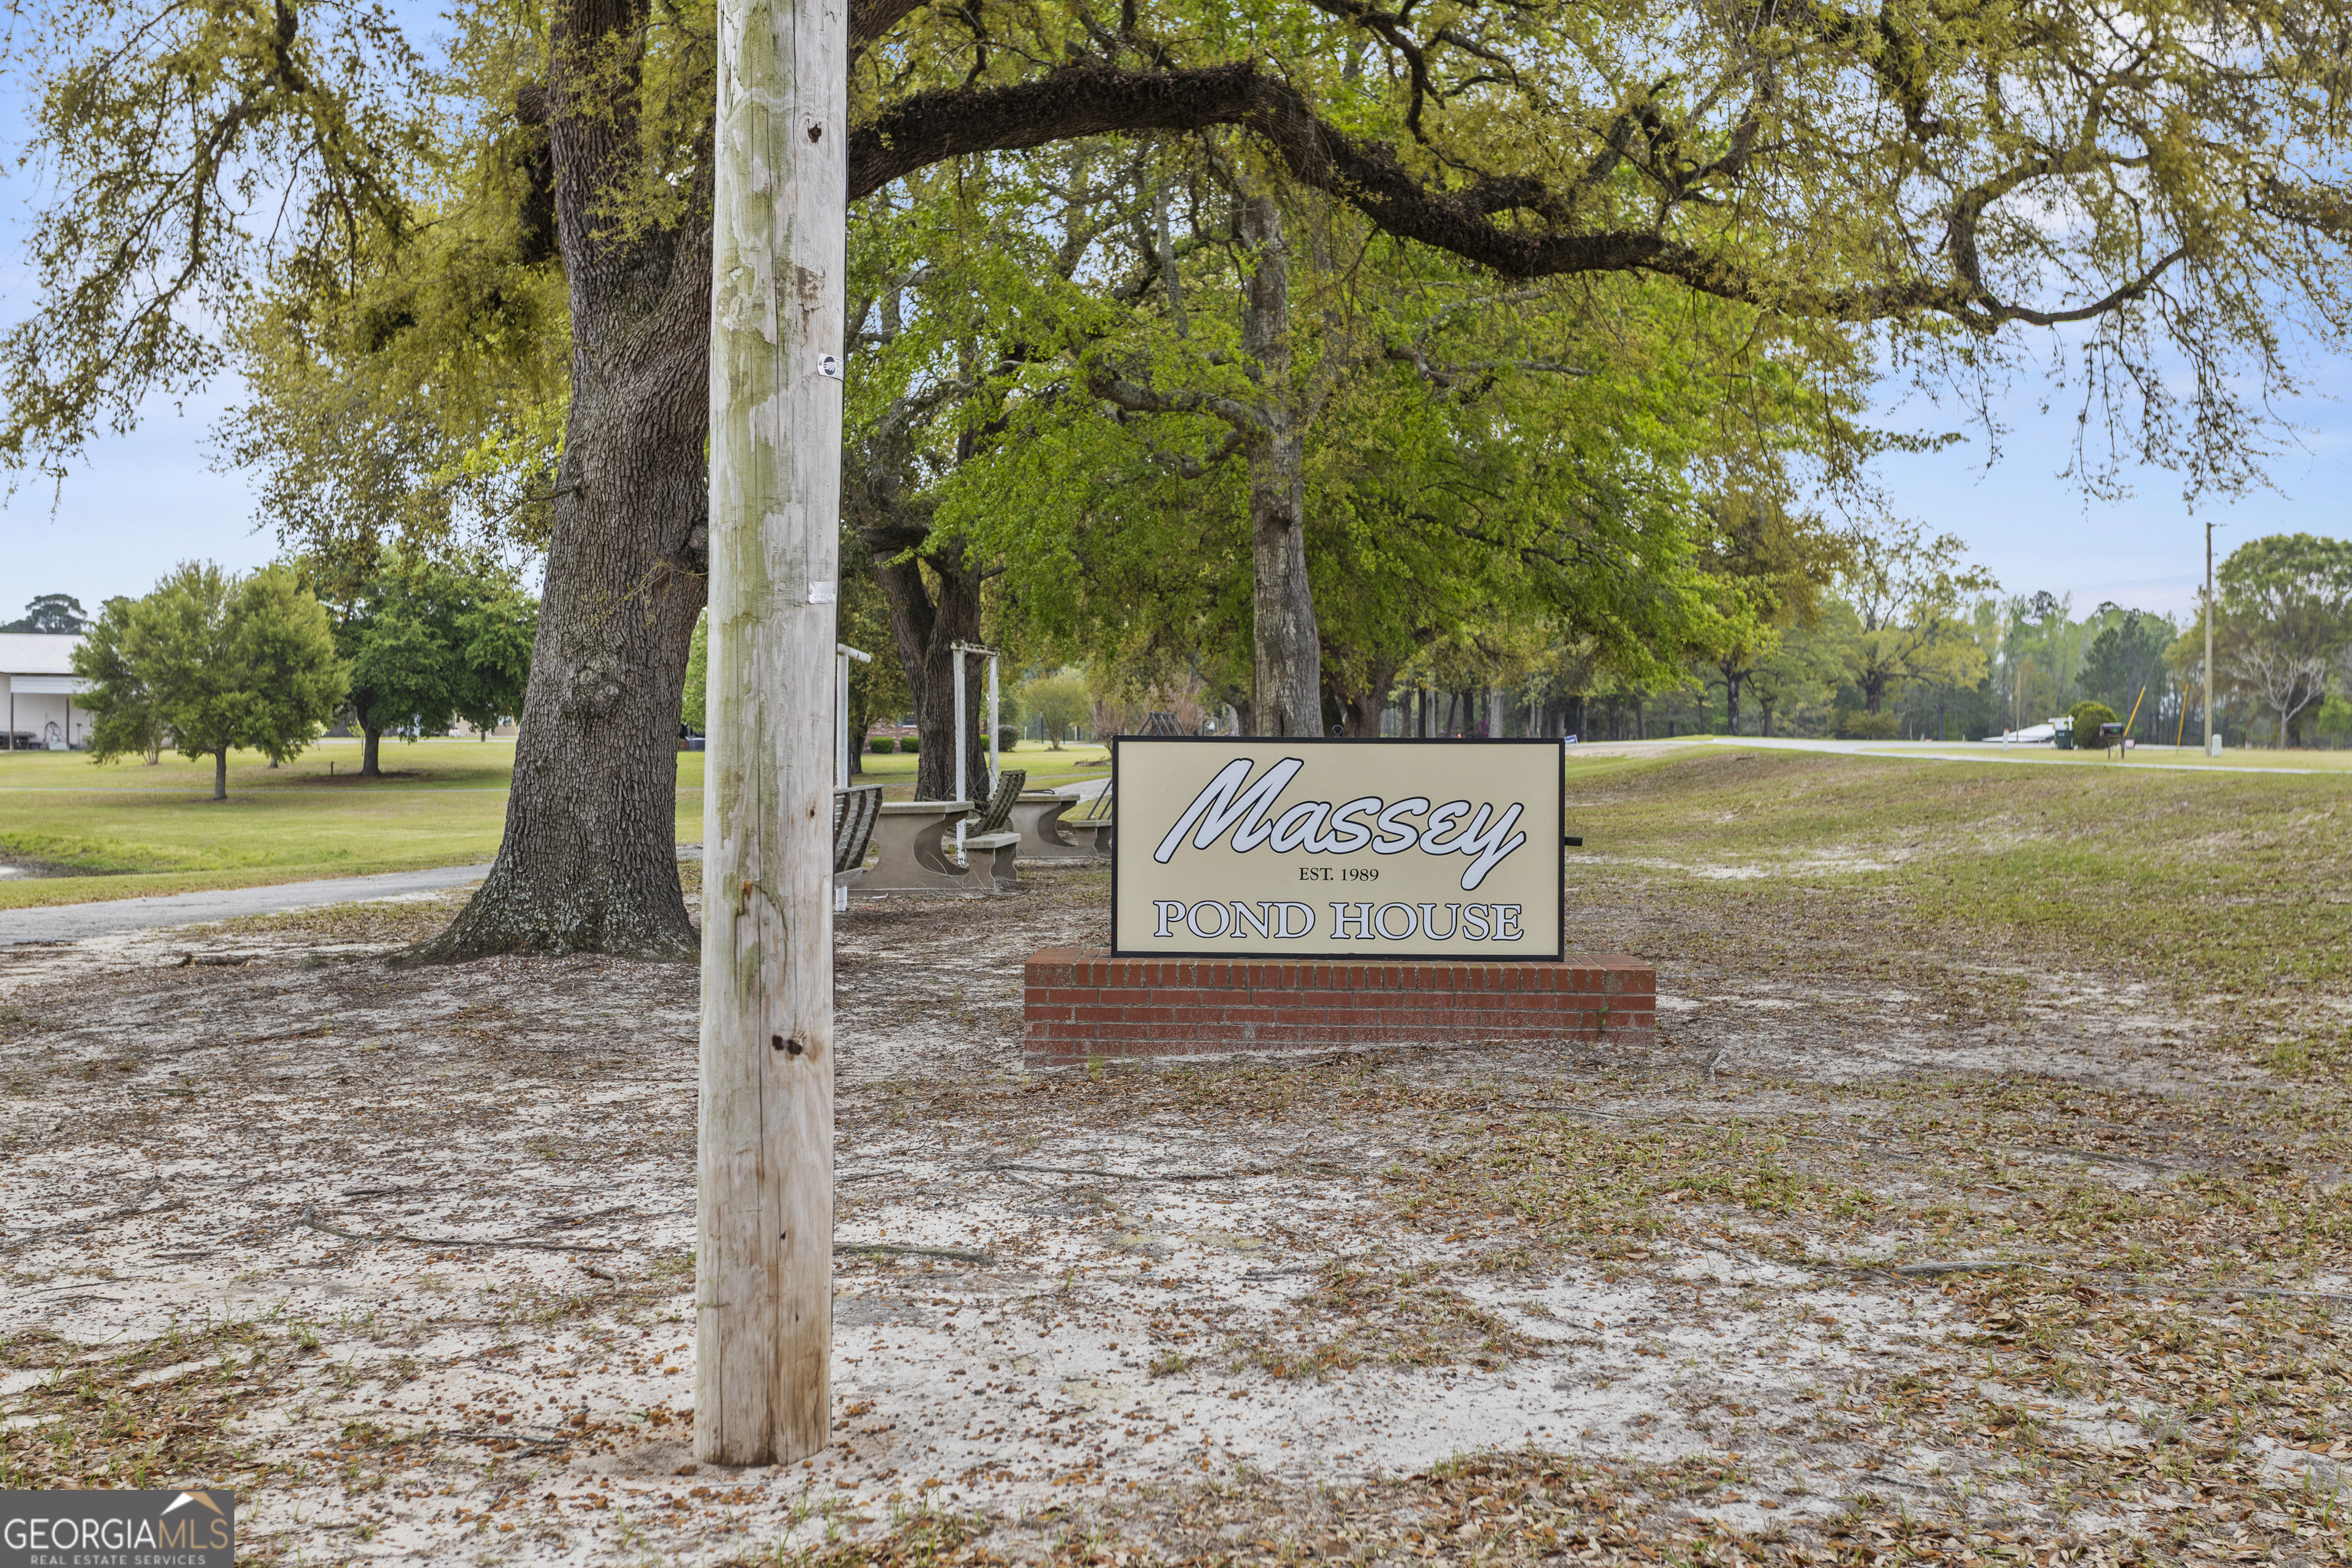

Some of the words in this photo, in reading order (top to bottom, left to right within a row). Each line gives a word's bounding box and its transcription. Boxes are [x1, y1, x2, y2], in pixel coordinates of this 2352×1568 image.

[1153, 757, 1527, 891] Massey
[1298, 867, 1334, 880] EST.
[1341, 868, 1379, 881] 1989
[1153, 900, 1316, 939] POND
[1329, 901, 1524, 941] HOUSE
